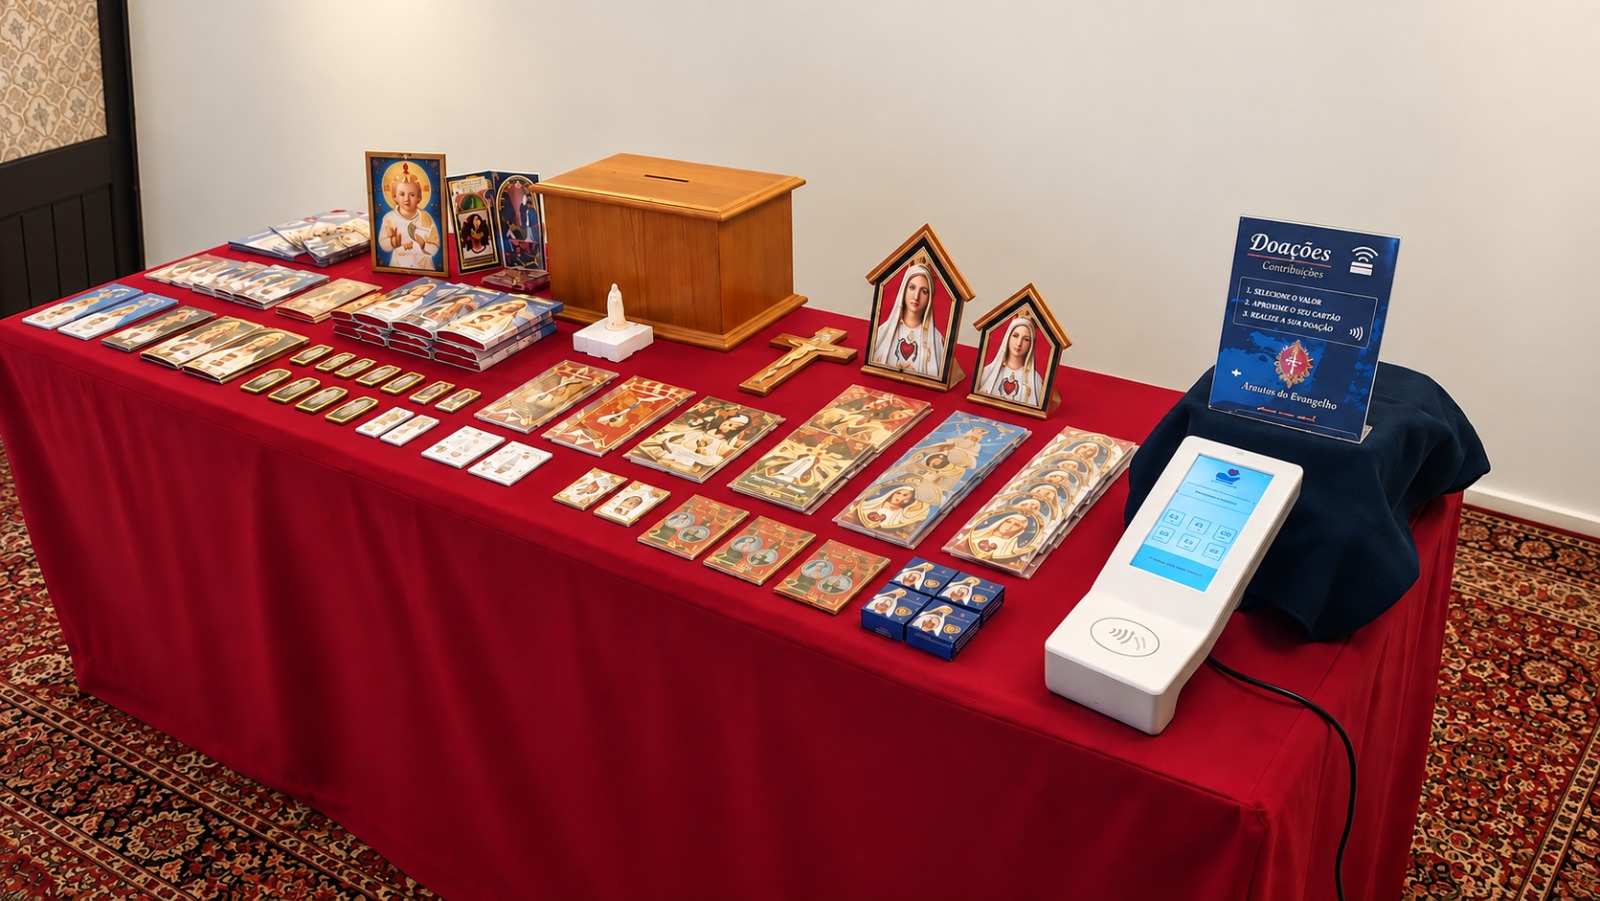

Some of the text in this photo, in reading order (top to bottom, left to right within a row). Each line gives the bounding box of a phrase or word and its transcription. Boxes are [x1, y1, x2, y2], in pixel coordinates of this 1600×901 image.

[1250, 233, 1331, 261] Doações
[1291, 294, 1298, 302] O
[1298, 296, 1322, 306] VALOR
[1277, 389, 1288, 399] do
[1290, 392, 1337, 410] Evangelho
